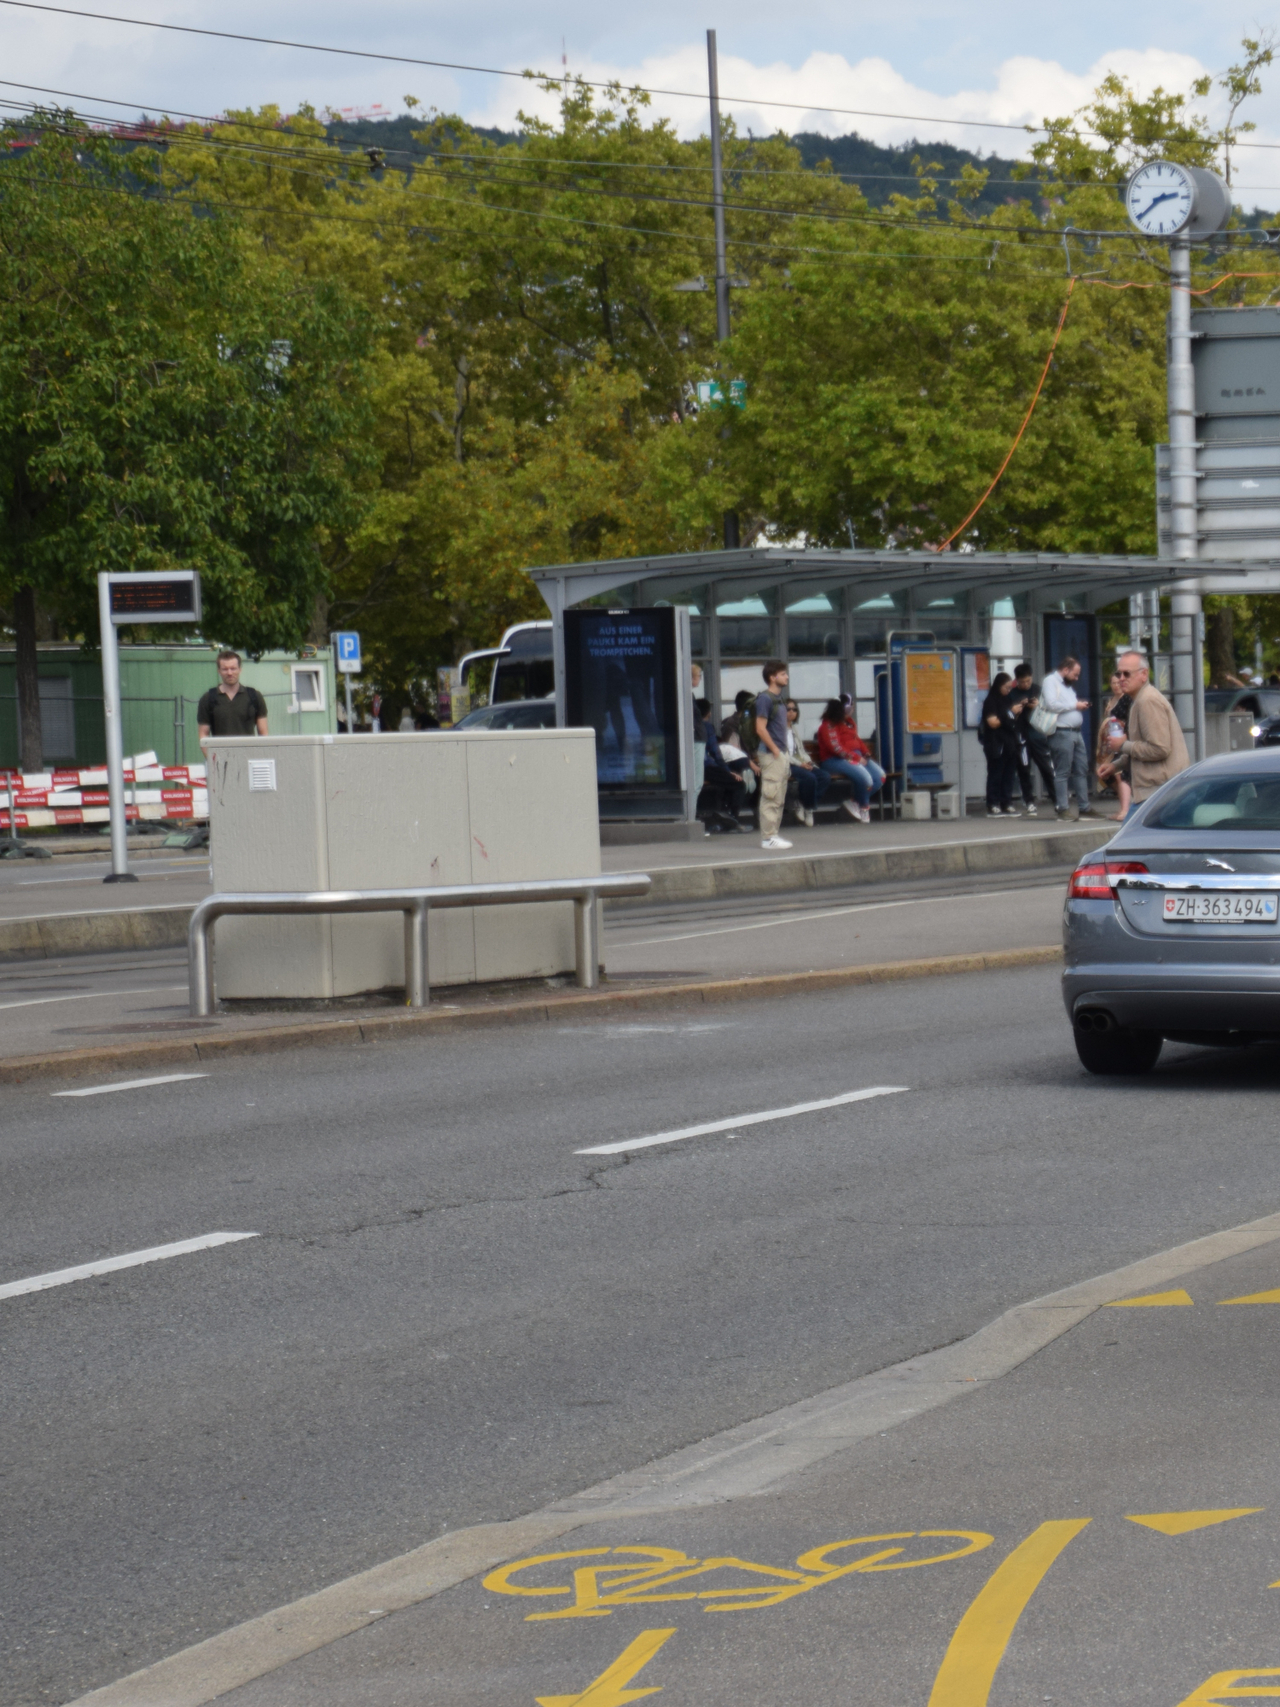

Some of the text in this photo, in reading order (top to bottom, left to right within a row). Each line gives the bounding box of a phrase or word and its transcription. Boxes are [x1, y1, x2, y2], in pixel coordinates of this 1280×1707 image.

[599, 625, 643, 635] AUS EINER
[587, 635, 655, 646] PAUKE KAM EIN
[344, 638, 354, 658] P
[589, 647, 654, 657] TROMPETCHEN.
